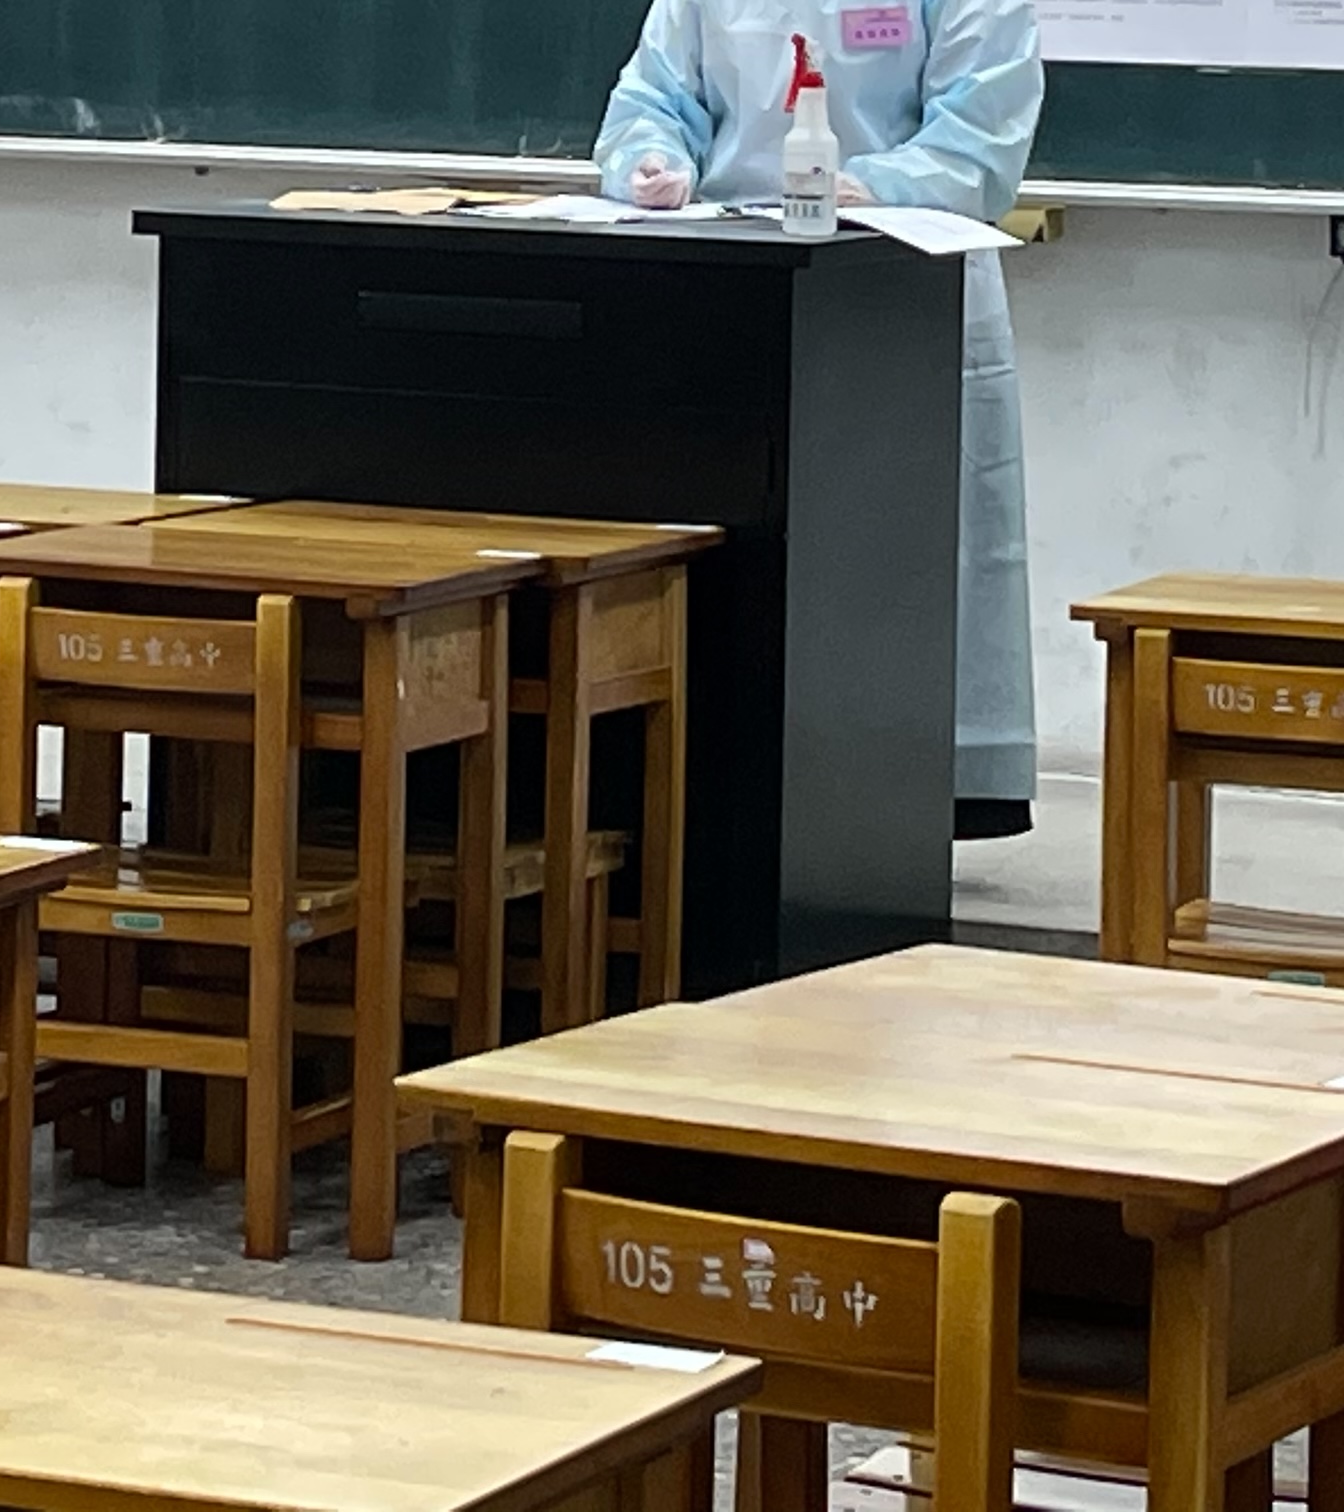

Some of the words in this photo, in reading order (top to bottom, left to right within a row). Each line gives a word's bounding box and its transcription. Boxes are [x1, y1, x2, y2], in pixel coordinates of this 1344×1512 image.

[58, 633, 103, 662] 105
[1206, 683, 1256, 713] 105
[602, 1239, 674, 1295] 105
[699, 1254, 880, 1328] 三重高中
